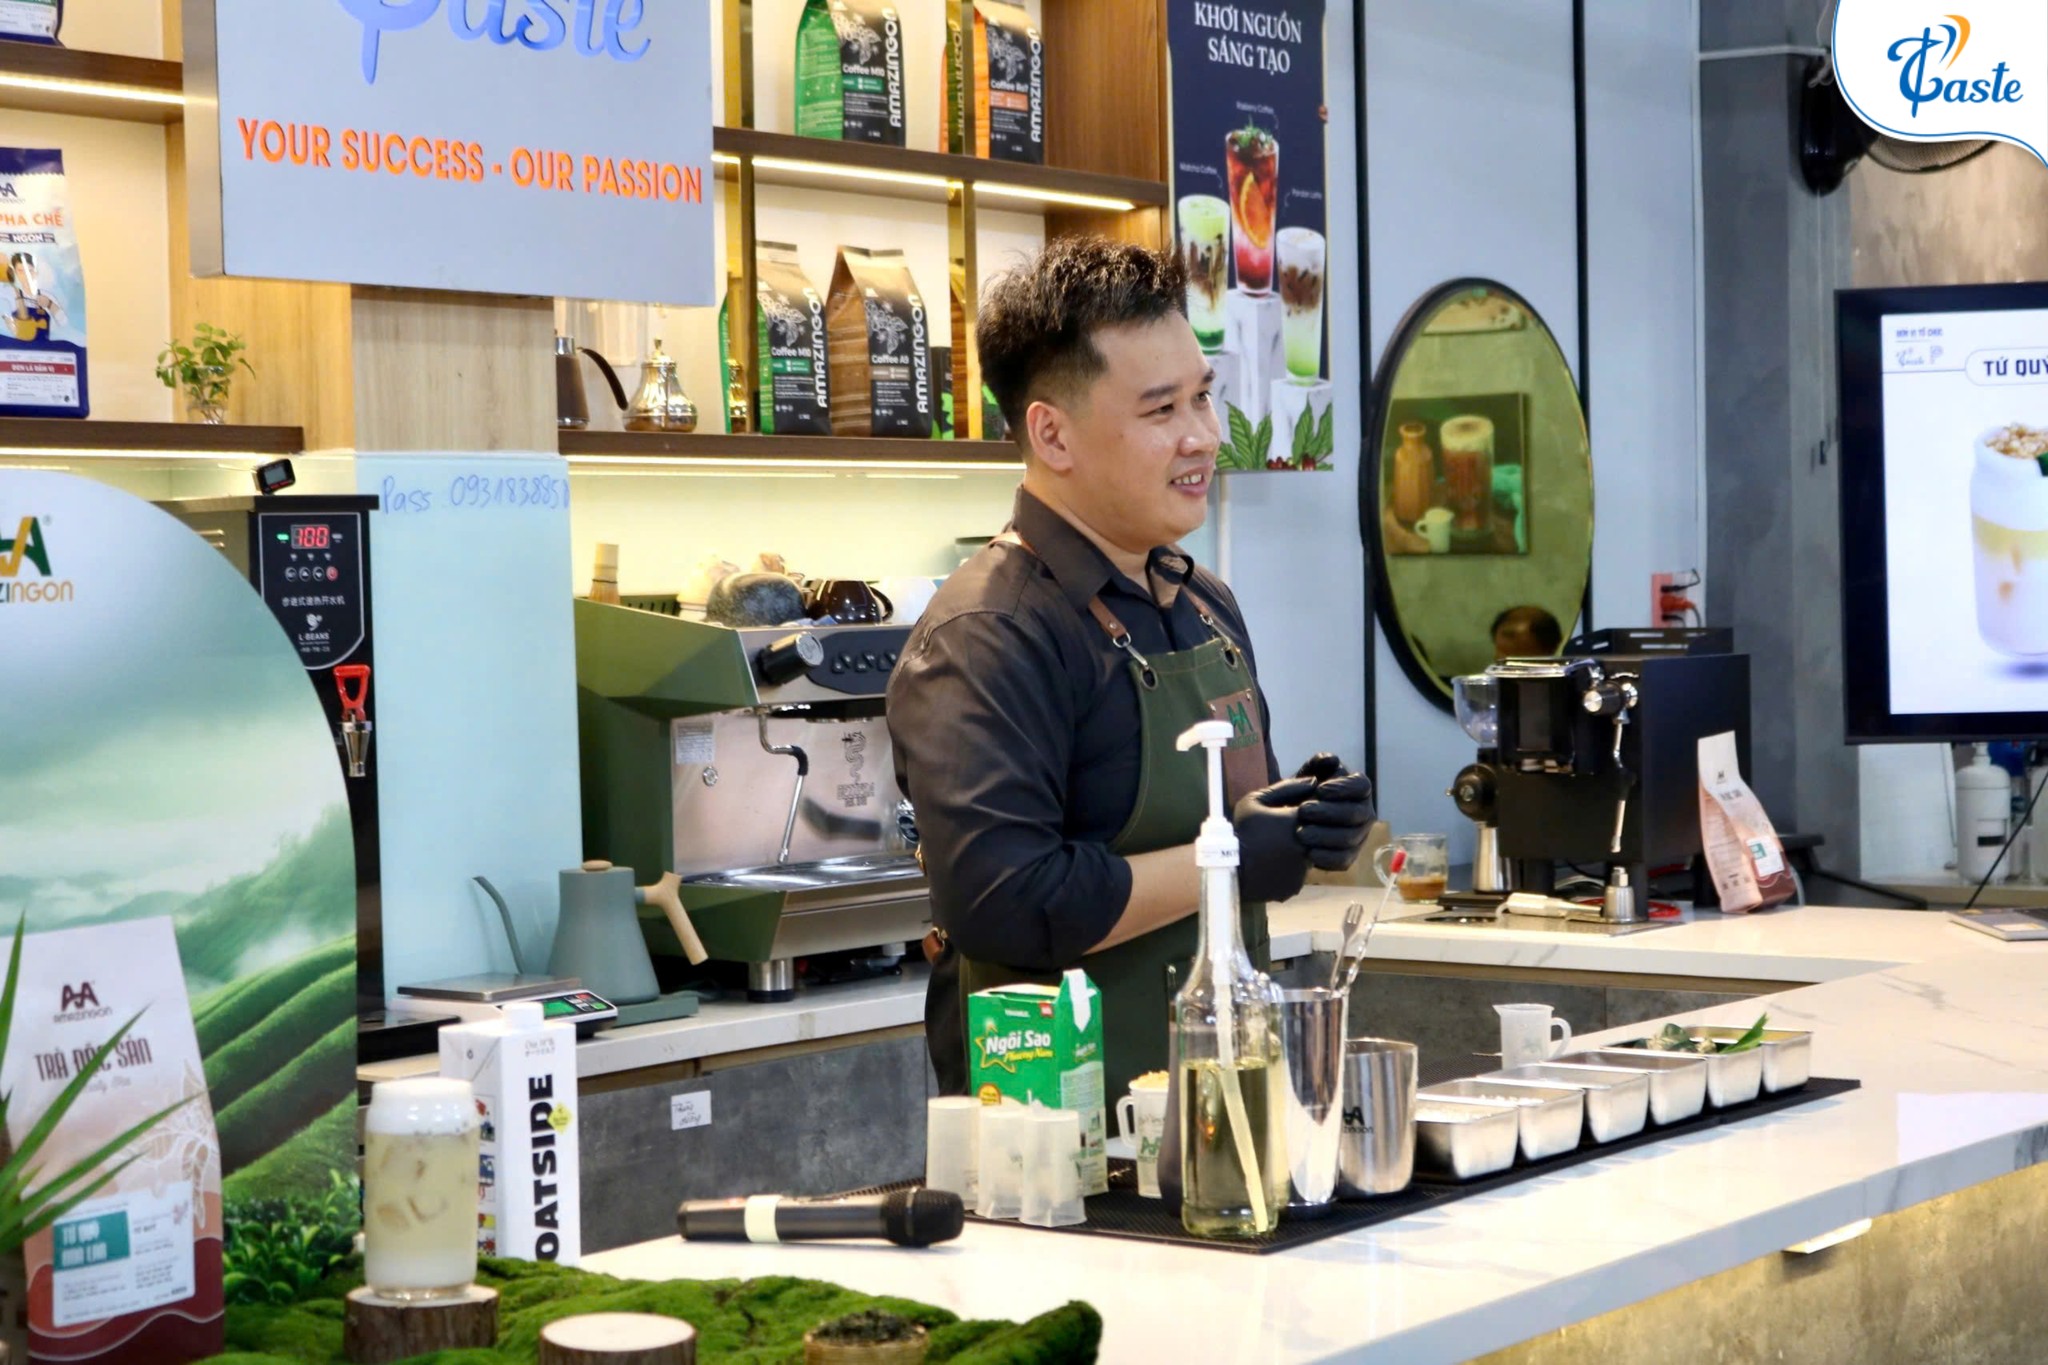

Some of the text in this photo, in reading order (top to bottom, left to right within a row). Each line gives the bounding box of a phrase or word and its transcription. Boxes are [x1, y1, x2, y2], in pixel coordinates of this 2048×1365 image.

[1208, 33, 1290, 75] SÁNG TẠO
[238, 116, 331, 167] YOUR
[341, 128, 484, 183] SUCCESS
[510, 147, 574, 192] OUR
[583, 155, 702, 204] PASSION
[383, 475, 432, 514] Pass
[299, 526, 329, 547] 100
[985, 1030, 1051, 1055] Ngôi Sao
[34, 1046, 69, 1081] TRÀ
[528, 1073, 560, 1262] OATSIDE
